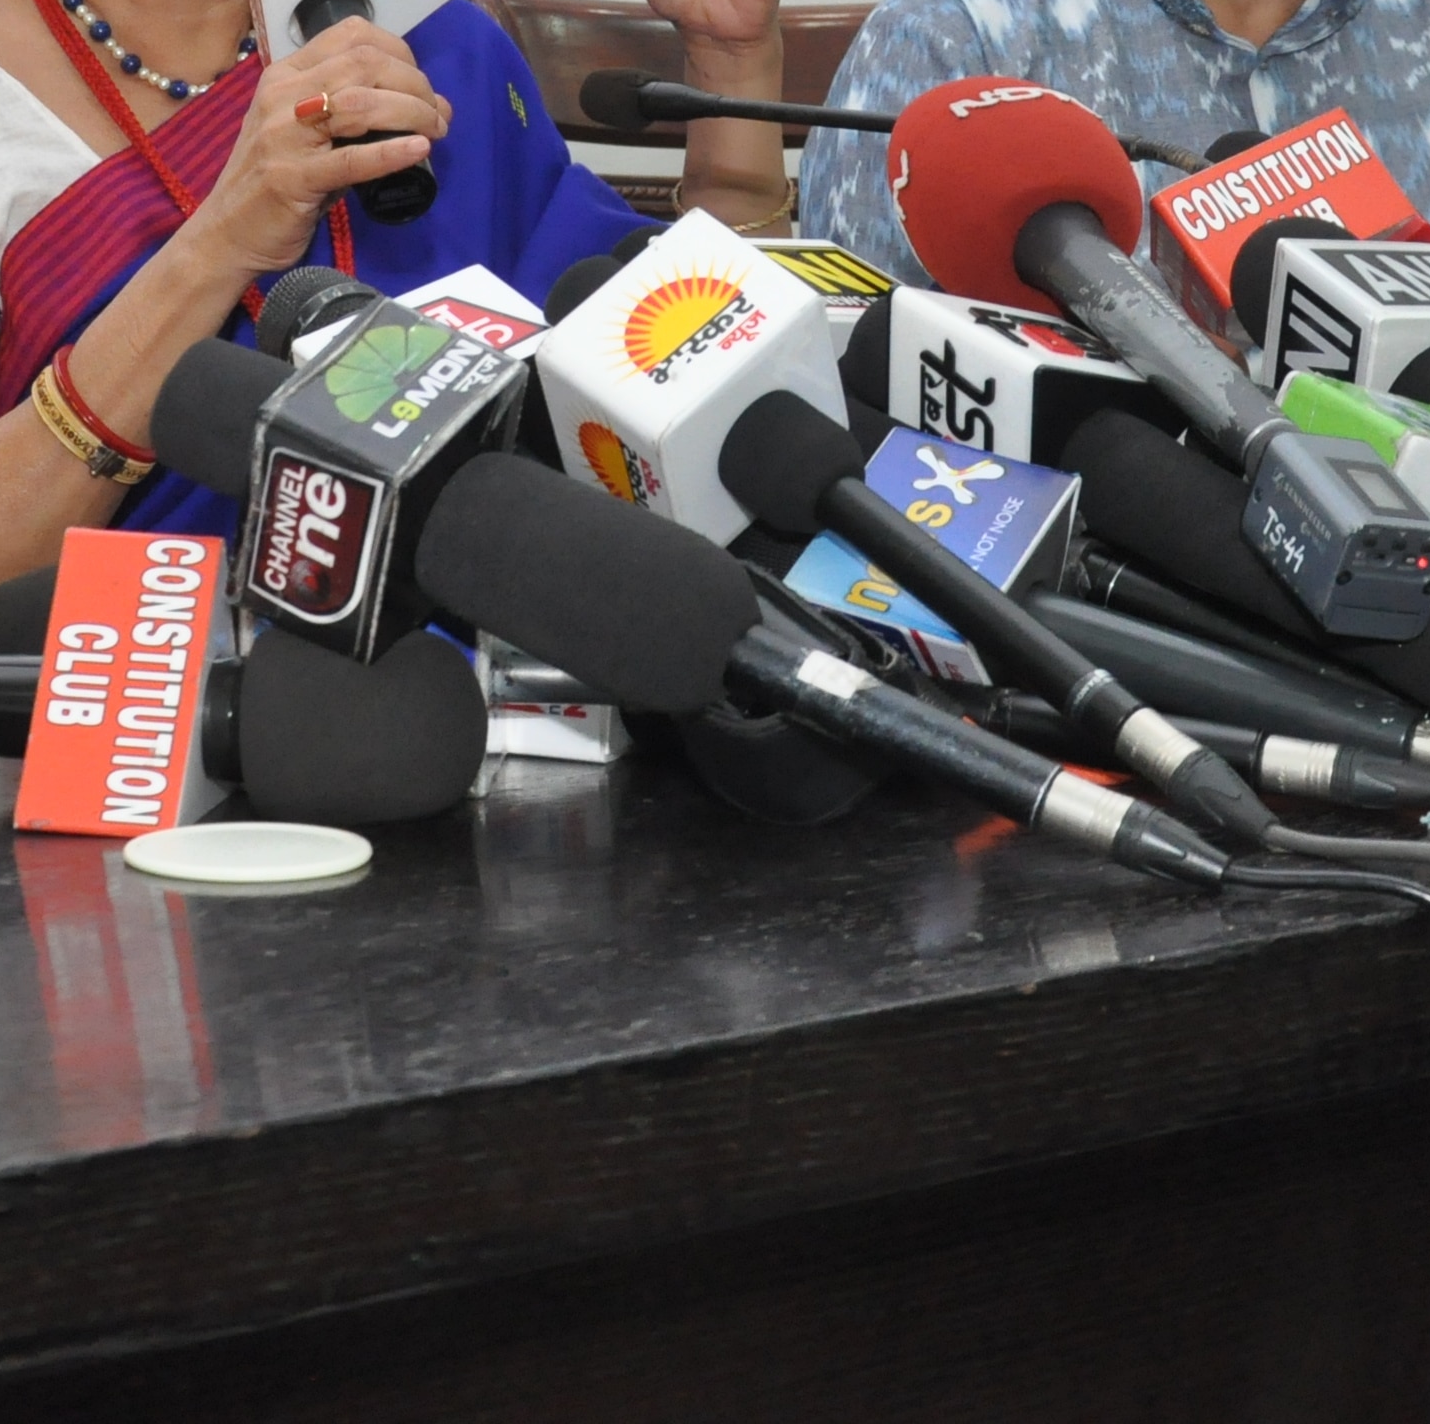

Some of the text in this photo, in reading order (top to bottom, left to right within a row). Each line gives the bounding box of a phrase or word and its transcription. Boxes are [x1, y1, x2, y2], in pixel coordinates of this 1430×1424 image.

[1172, 120, 1370, 240] CONSTITUTION
[264, 466, 307, 591] CHANNEL
[969, 496, 1025, 564] NOT NOISE
[46, 623, 120, 726] CLUB
[101, 538, 207, 826] CONSTITUTION
